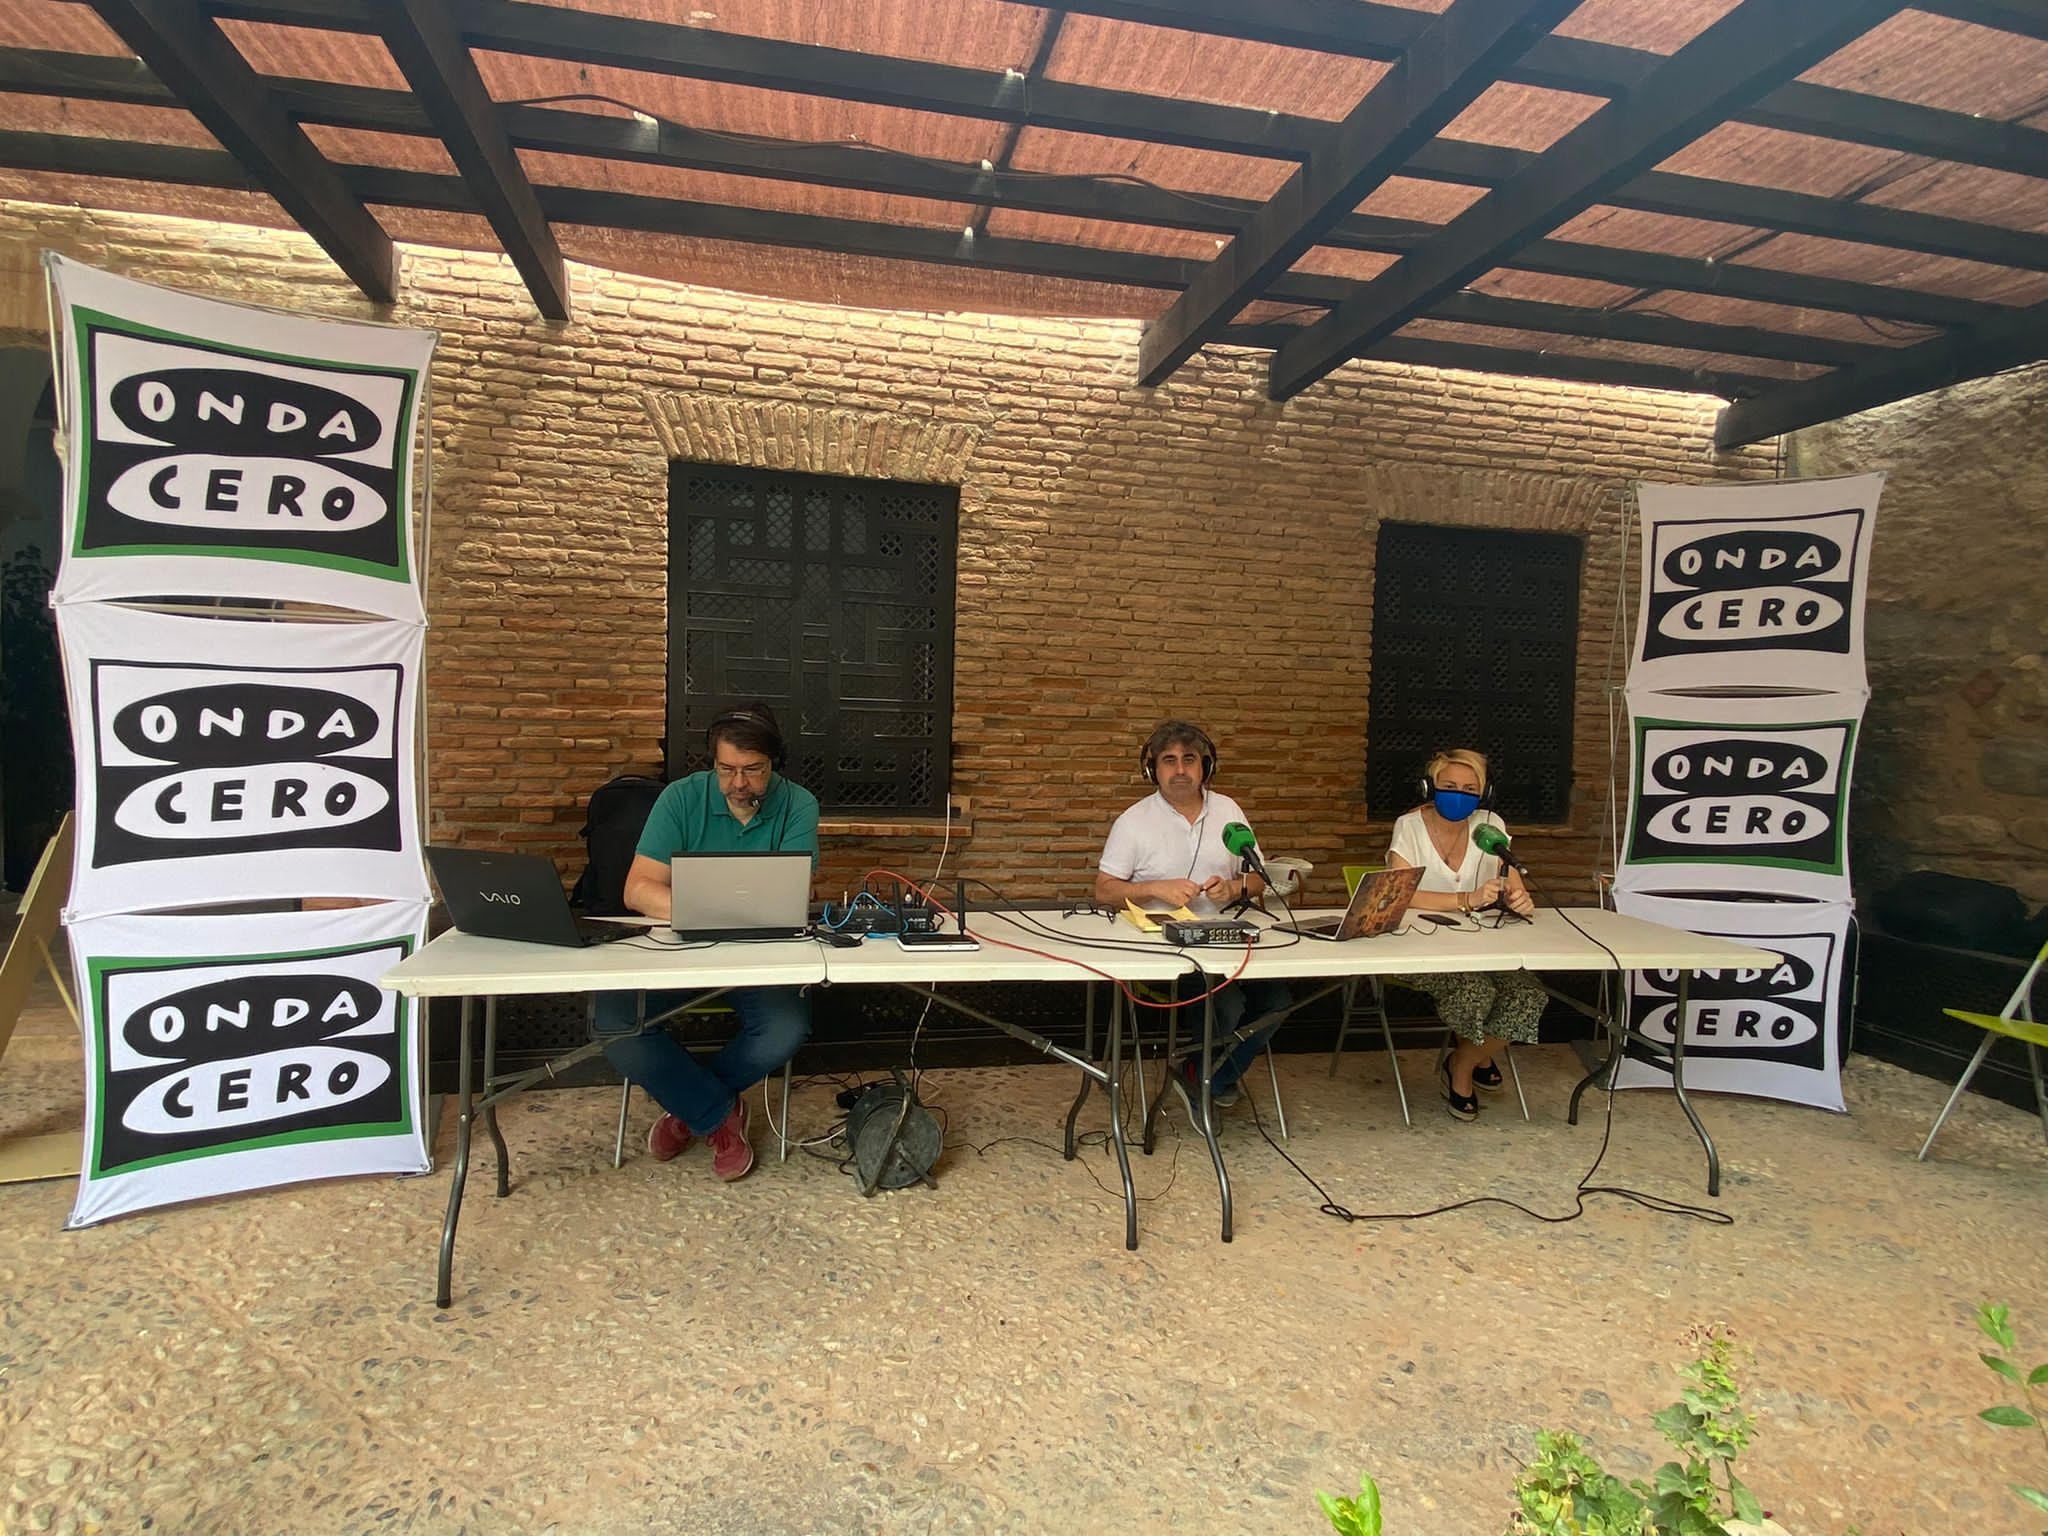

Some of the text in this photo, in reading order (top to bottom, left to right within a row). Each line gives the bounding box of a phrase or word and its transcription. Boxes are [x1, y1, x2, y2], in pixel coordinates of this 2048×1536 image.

[139, 382, 356, 442] ONDA
[149, 465, 354, 521] CERO
[1679, 545, 1822, 575] ONDA
[1683, 598, 1819, 630] CERO
[141, 705, 355, 743] ONDA
[1667, 755, 1809, 779] ONDA
[155, 780, 357, 824] CERO
[1671, 805, 1807, 836] CERO
[480, 891, 520, 905] VAIO
[150, 991, 359, 1042] ONDA
[163, 1062, 360, 1118] CERO
